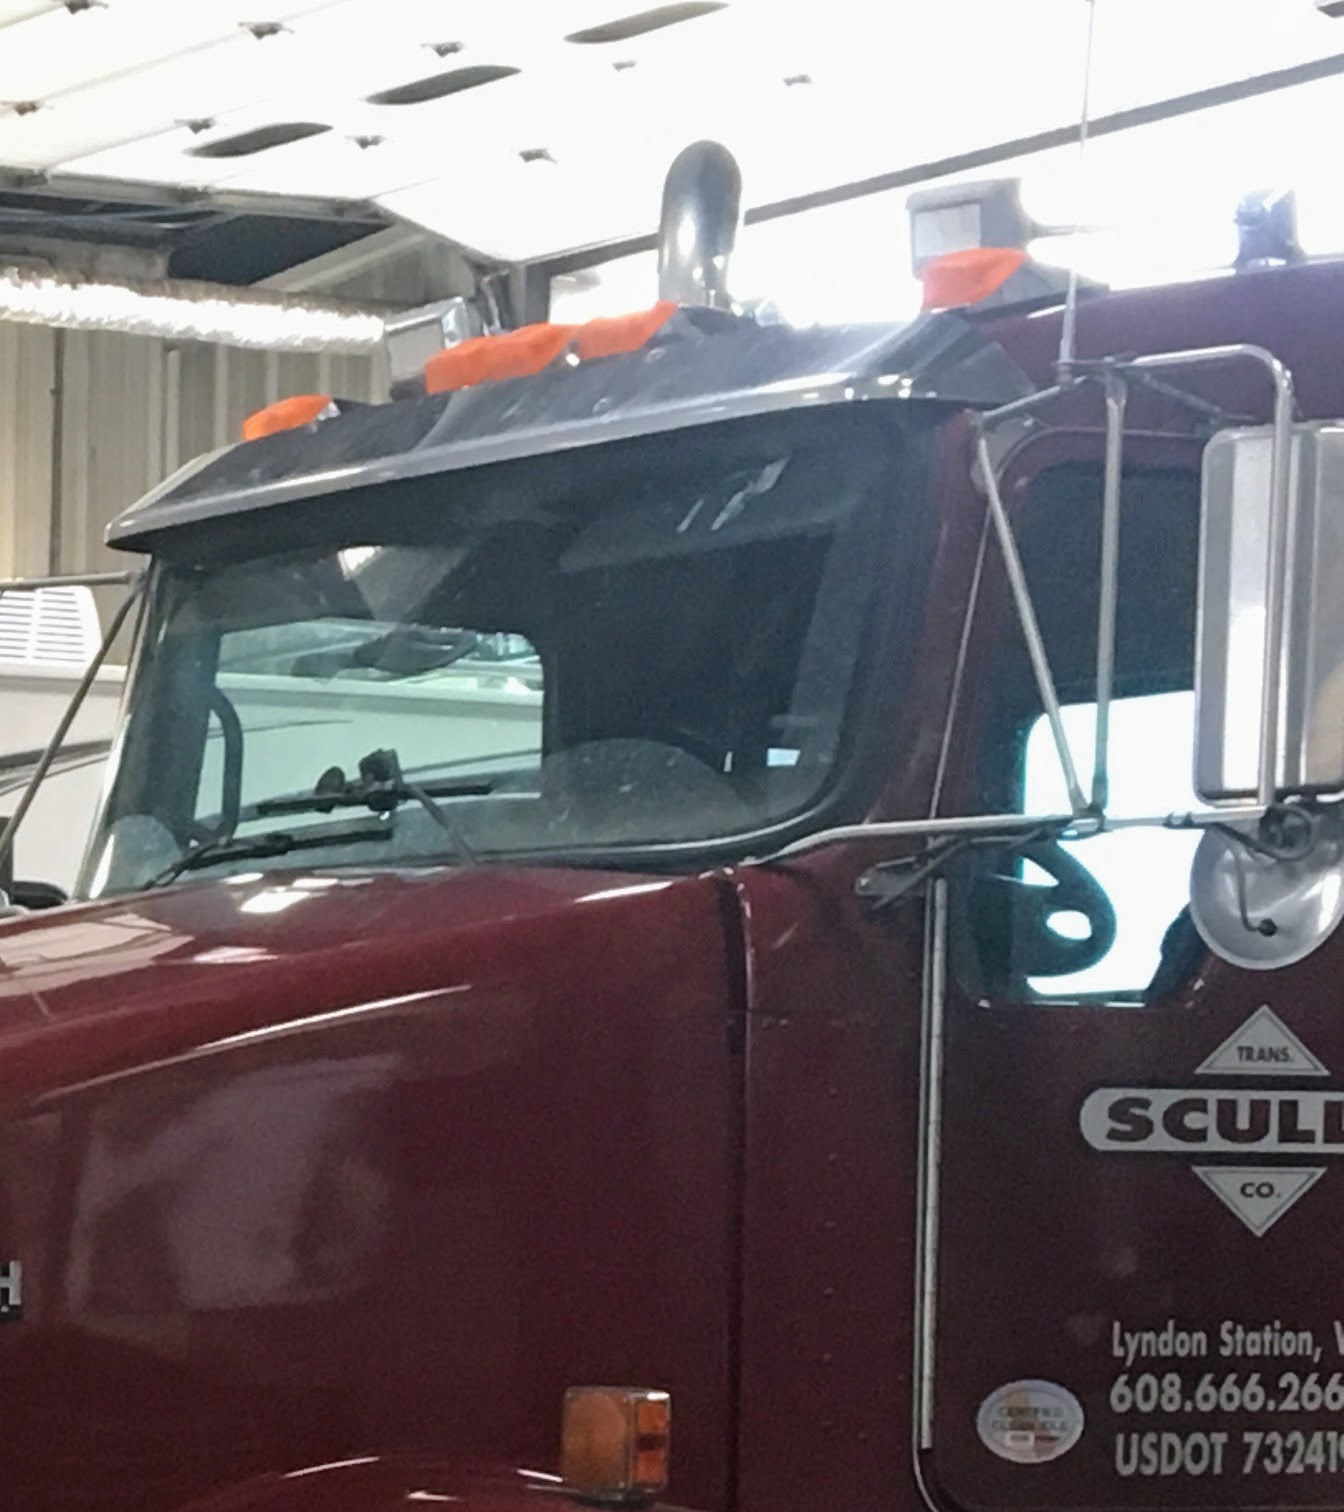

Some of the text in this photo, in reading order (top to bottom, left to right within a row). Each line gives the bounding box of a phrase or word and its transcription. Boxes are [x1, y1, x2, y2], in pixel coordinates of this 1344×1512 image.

[1237, 1045, 1295, 1063] TRANS.
[1240, 1181, 1282, 1199] CO.
[1113, 1320, 1208, 1367] Lyndon
[1219, 1319, 1322, 1364] Station,
[1109, 1371, 1344, 1413] 608.666.266
[1115, 1431, 1344, 1476] USDOT 73241
